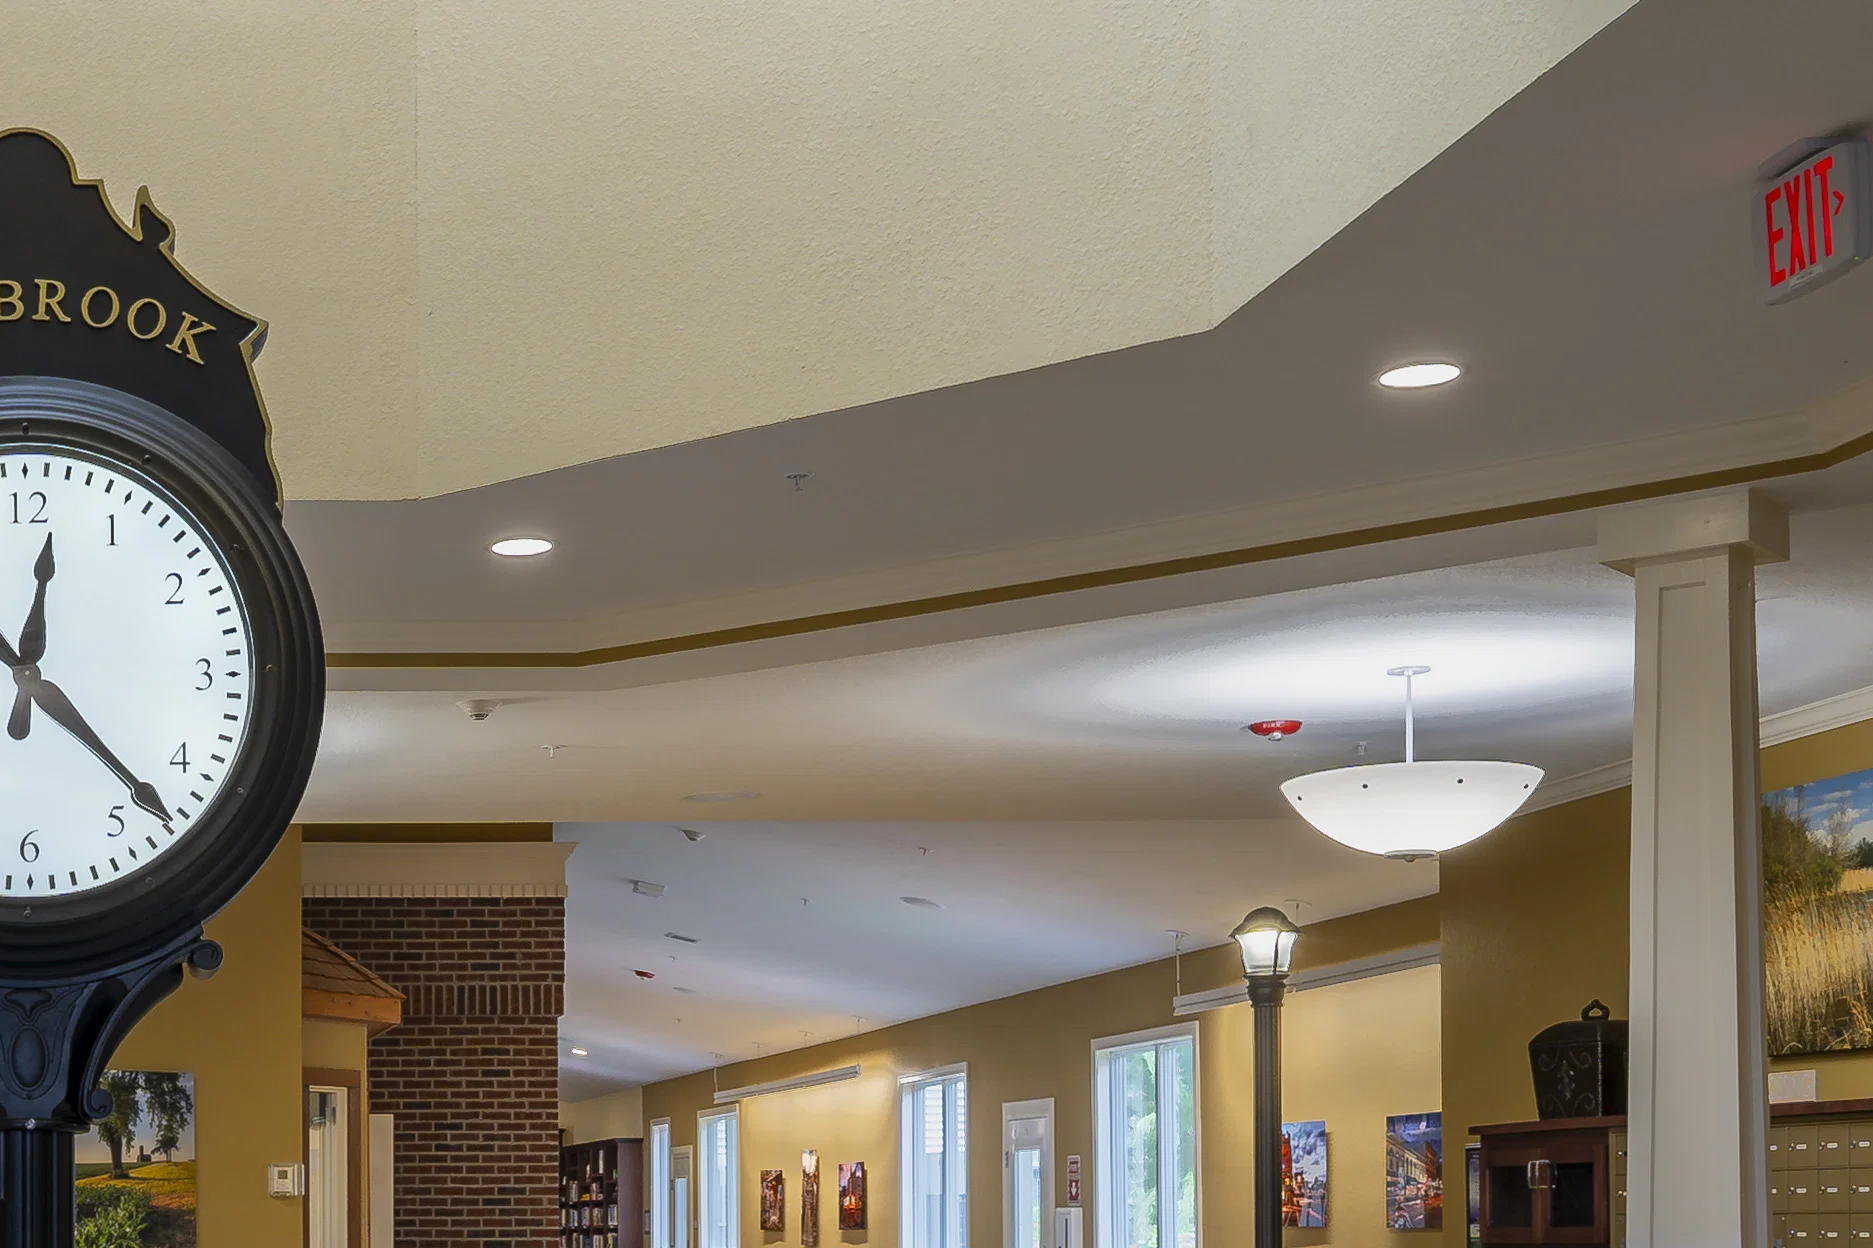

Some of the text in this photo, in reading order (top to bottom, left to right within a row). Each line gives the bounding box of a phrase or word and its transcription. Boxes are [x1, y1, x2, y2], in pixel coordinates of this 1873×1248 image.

[1765, 156, 1833, 287] EXIT
[11, 491, 49, 524] 12
[106, 513, 119, 547] 1
[165, 573, 184, 604] 2
[196, 658, 212, 690] 3
[170, 742, 190, 773] 4
[107, 806, 124, 837] 5
[20, 830, 39, 862] 6
